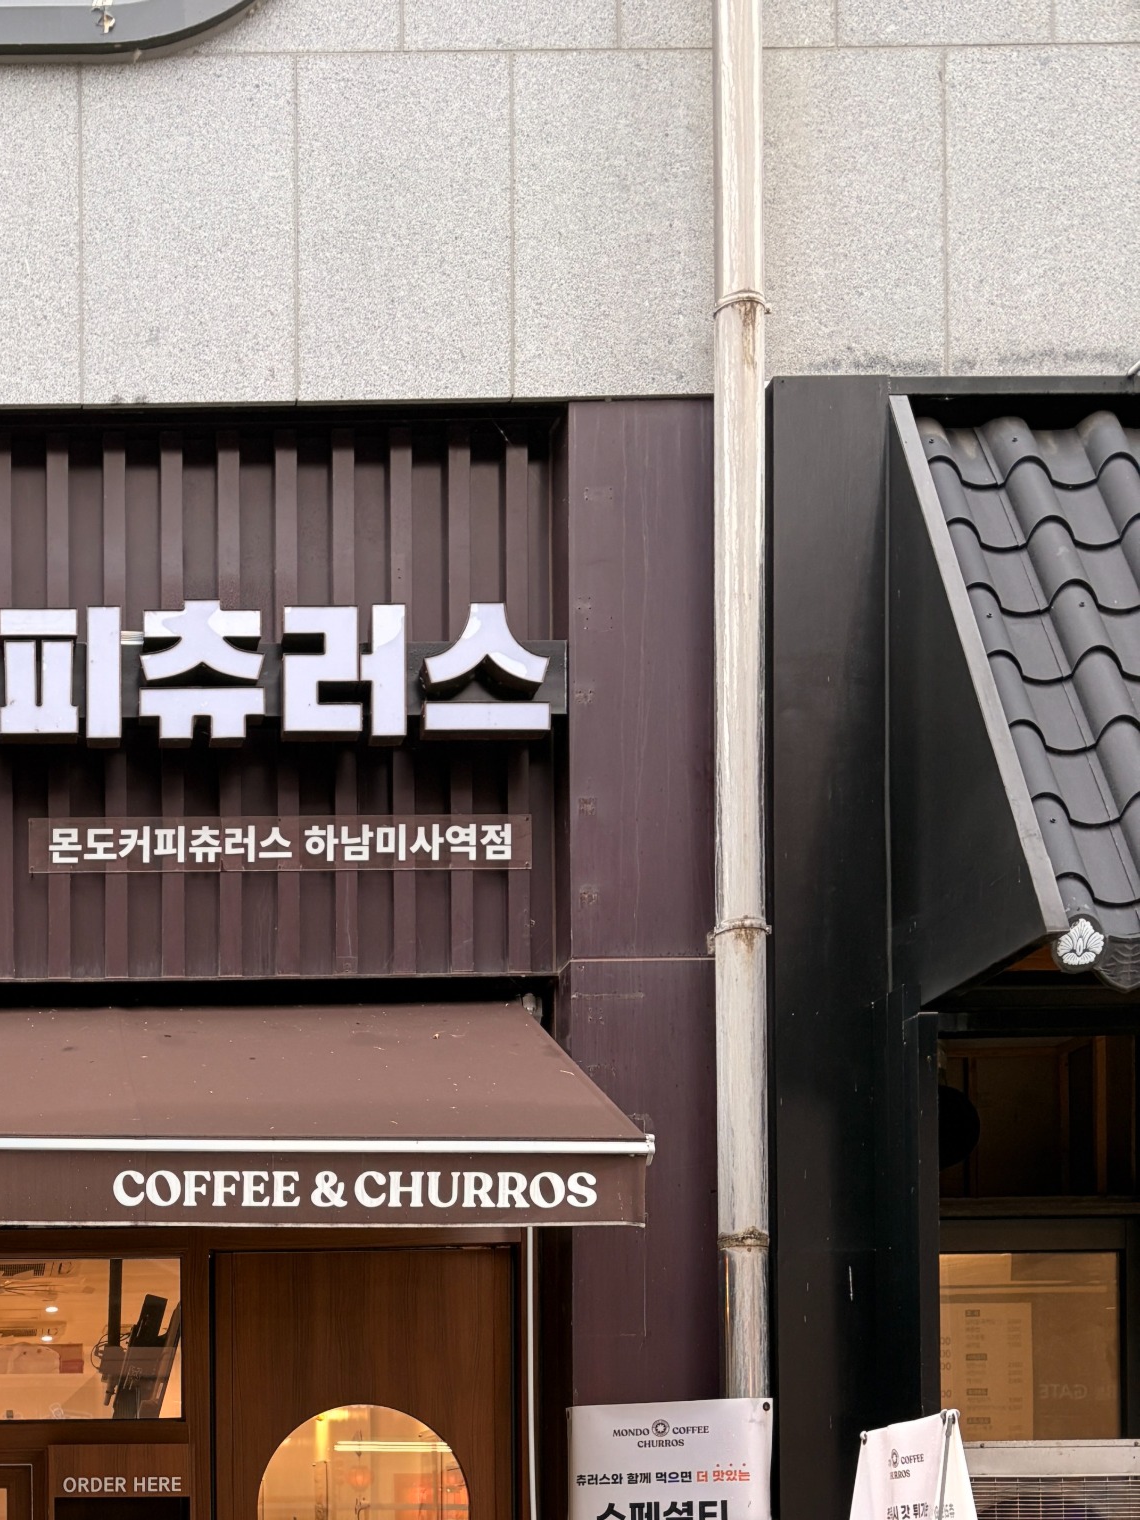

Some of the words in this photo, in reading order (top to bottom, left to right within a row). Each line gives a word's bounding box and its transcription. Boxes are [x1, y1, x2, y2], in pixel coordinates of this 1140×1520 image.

[48, 826, 293, 864] 몬도커피츄러스
[304, 824, 513, 862] 하남미사역점
[112, 1169, 301, 1208] COFFEE
[310, 1170, 348, 1209] &
[354, 1171, 598, 1209] CHURROS
[612, 1427, 650, 1438] MONDO
[672, 1425, 710, 1435] COFFEE
[637, 1438, 685, 1449] CHURROS
[900, 1453, 925, 1465] COFFEE
[63, 1476, 127, 1493] ORDER
[133, 1476, 182, 1492] HERE
[576, 1472, 623, 1486] 츄러스와
[627, 1472, 652, 1485] 함께
[655, 1471, 693, 1484] 먹으면
[696, 1471, 709, 1483] 더
[712, 1470, 751, 1483] 맛있는
